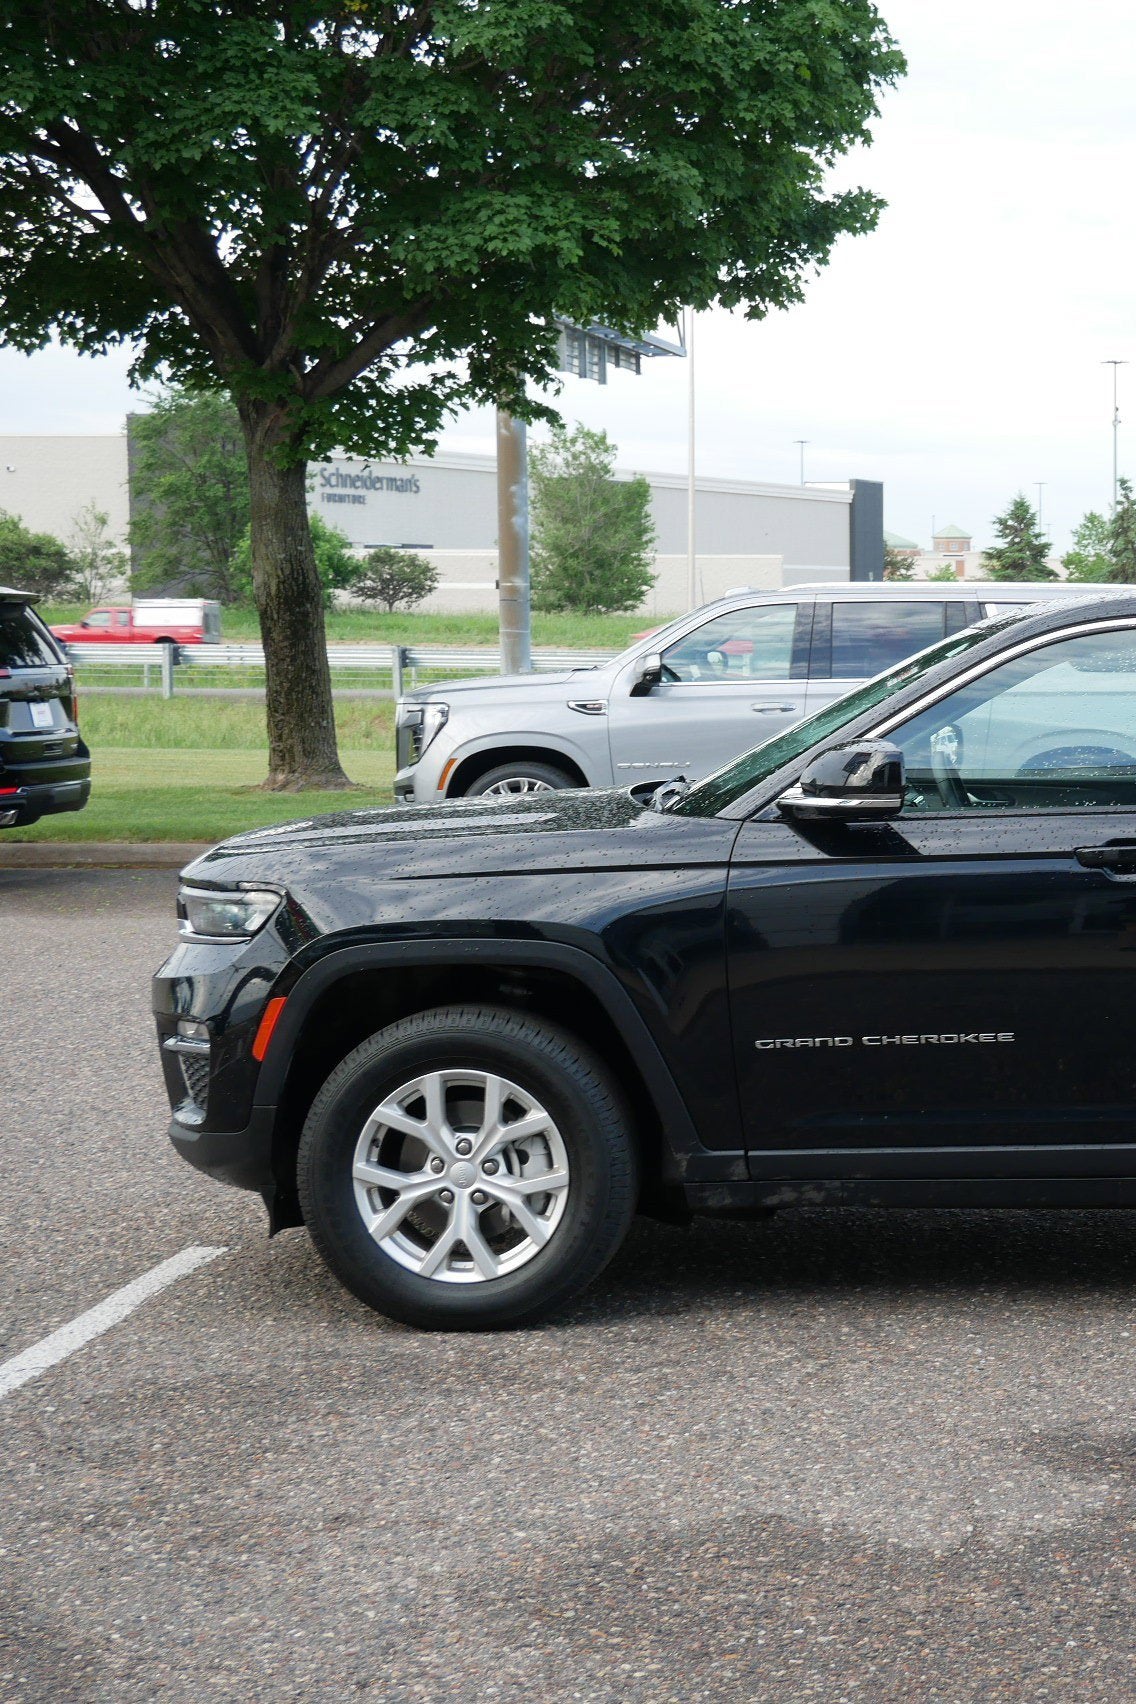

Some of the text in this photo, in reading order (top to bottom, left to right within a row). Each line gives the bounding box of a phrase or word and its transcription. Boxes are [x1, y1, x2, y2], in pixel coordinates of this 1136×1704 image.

[320, 467, 420, 494] Schneiderman's
[754, 1032, 1016, 1049] GRAND CHEROKEE
